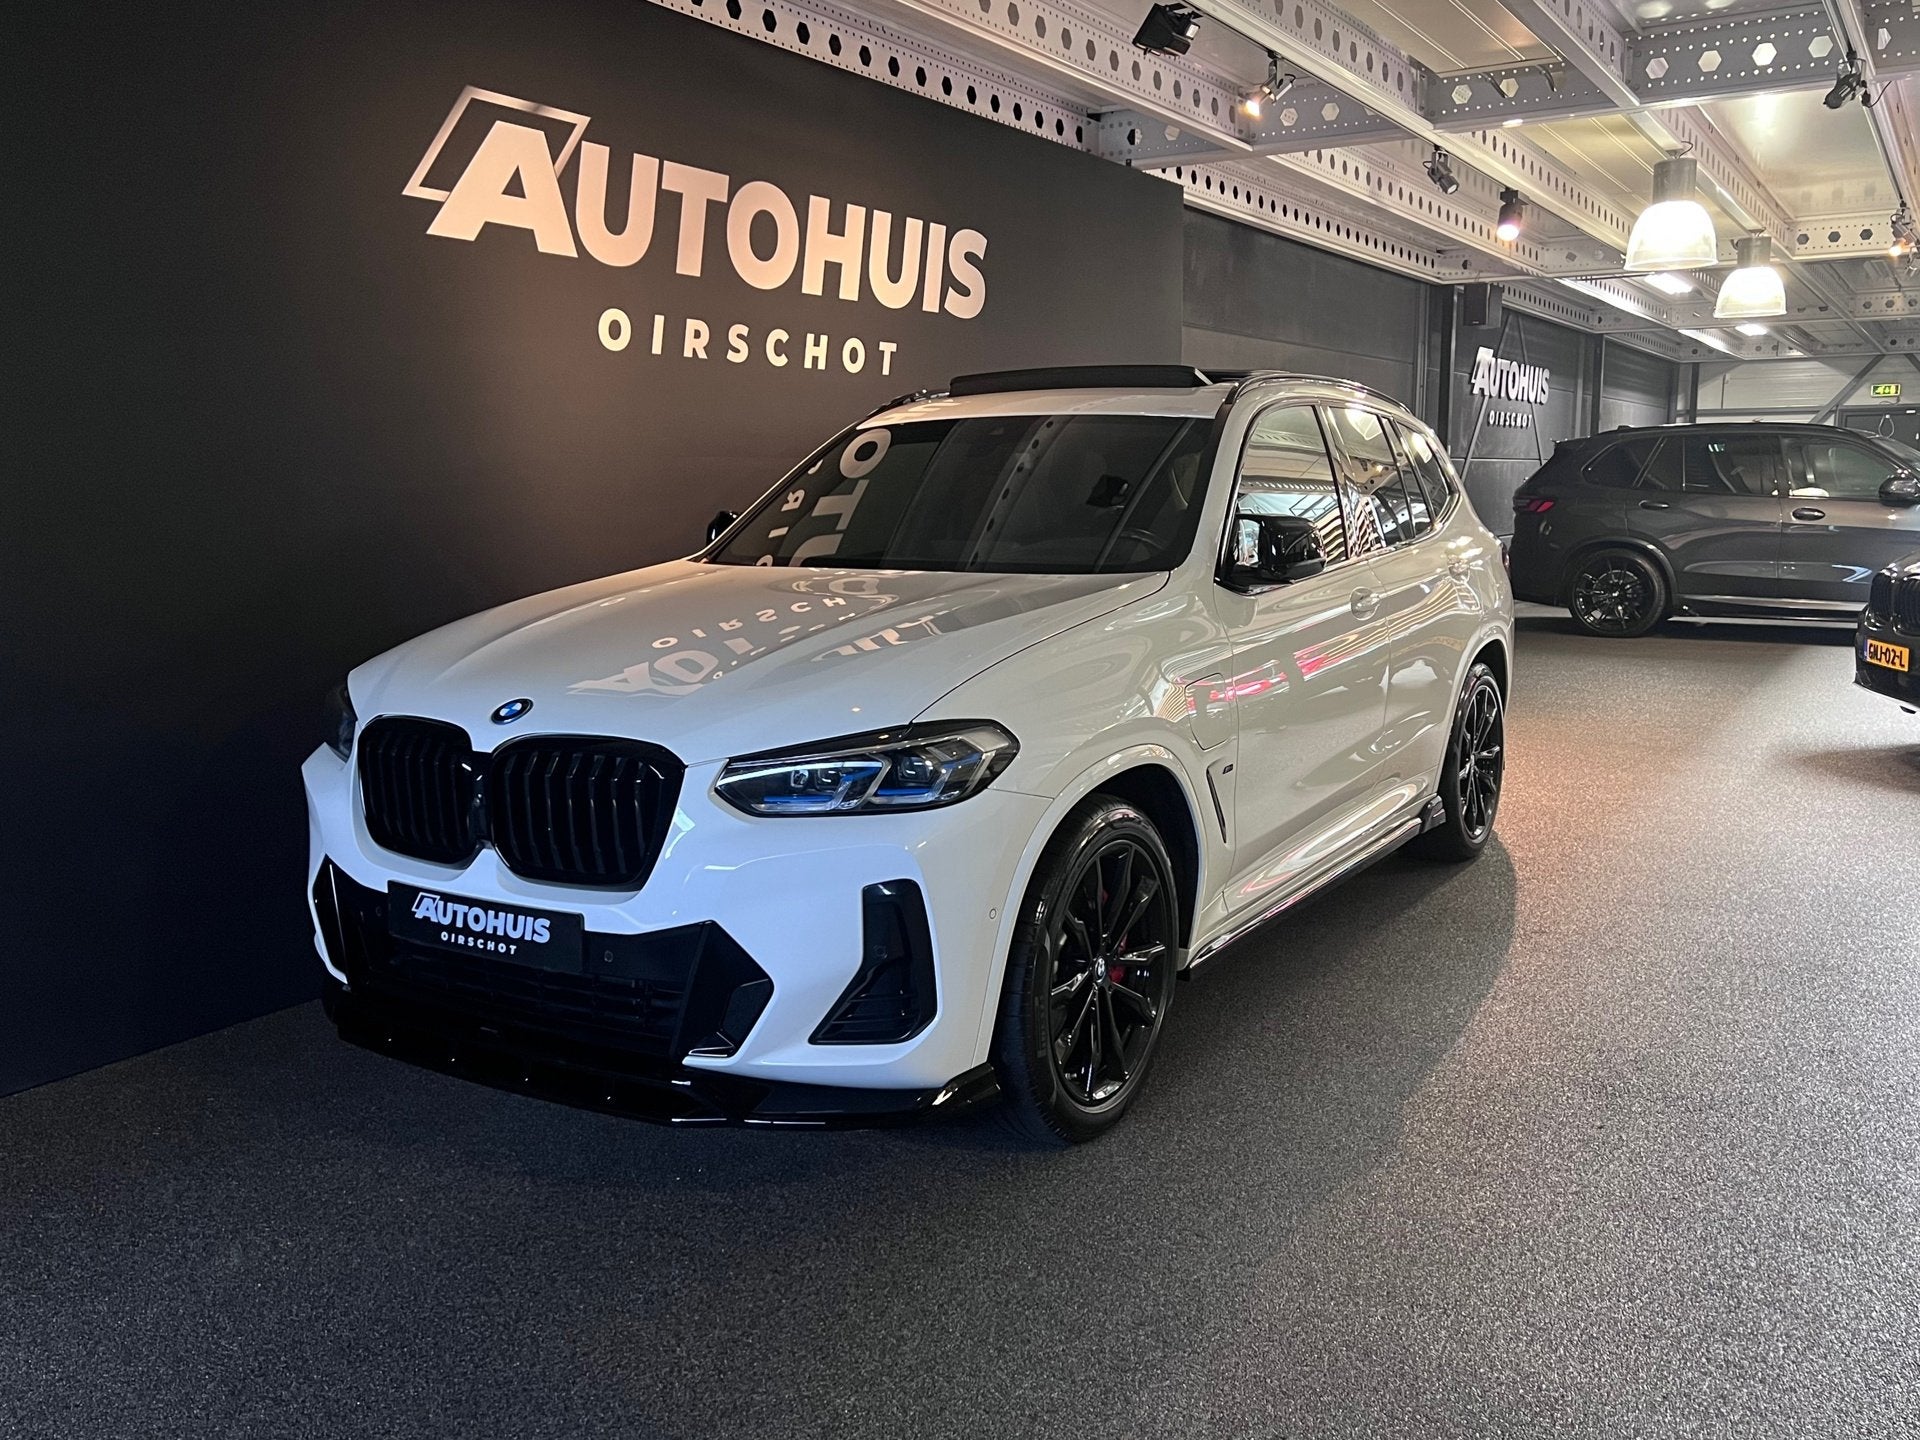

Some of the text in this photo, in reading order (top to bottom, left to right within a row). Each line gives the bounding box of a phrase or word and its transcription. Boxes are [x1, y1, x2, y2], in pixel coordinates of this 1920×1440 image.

[425, 119, 989, 320] AUTOHUIS
[598, 307, 898, 376] OIRSCHOT
[1472, 353, 1550, 404] AUTOHUIS
[1489, 410, 1532, 428] OIRSCHOT
[414, 897, 551, 944] AUTOHUIS
[440, 931, 517, 956] OIRSCHOT
